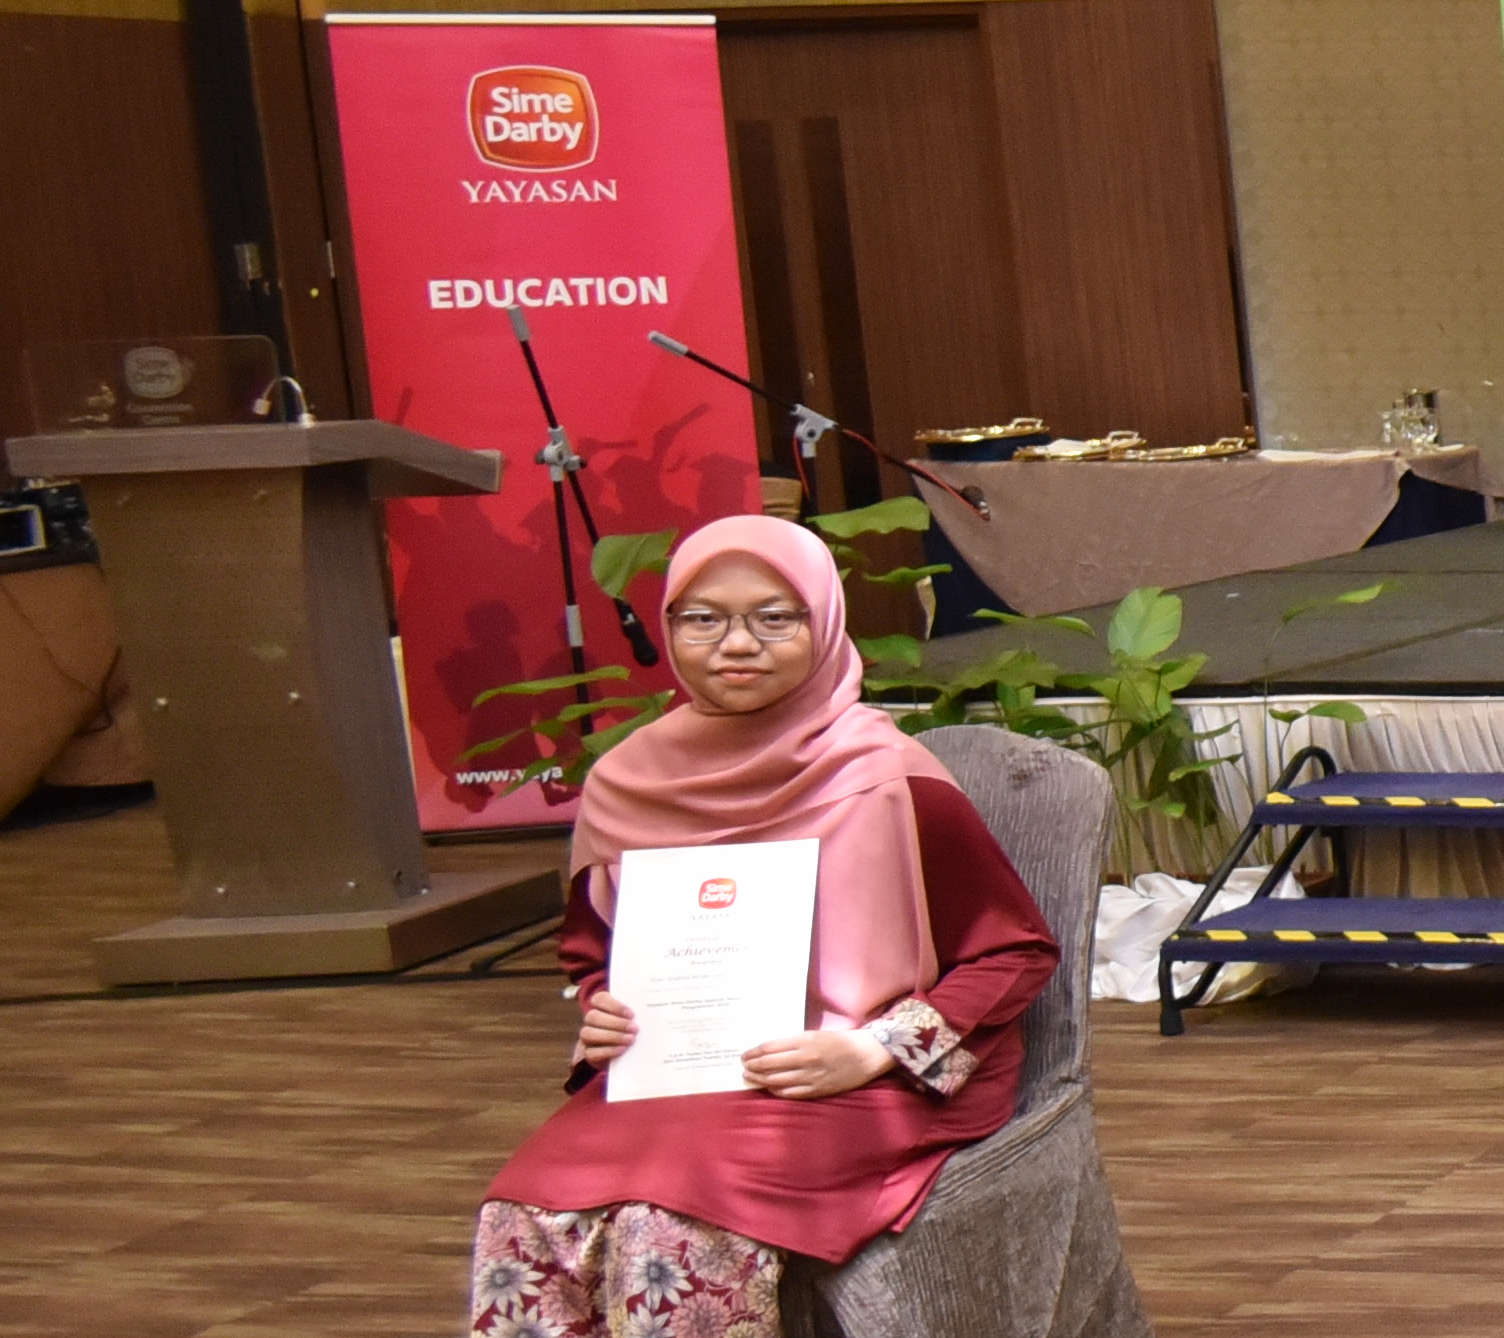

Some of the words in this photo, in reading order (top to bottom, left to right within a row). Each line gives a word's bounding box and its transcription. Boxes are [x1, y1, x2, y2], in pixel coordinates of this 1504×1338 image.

[491, 87, 574, 114] Sime
[485, 114, 584, 151] Darby
[461, 179, 618, 203] YAYASAN
[428, 277, 669, 309] EDUCATION
